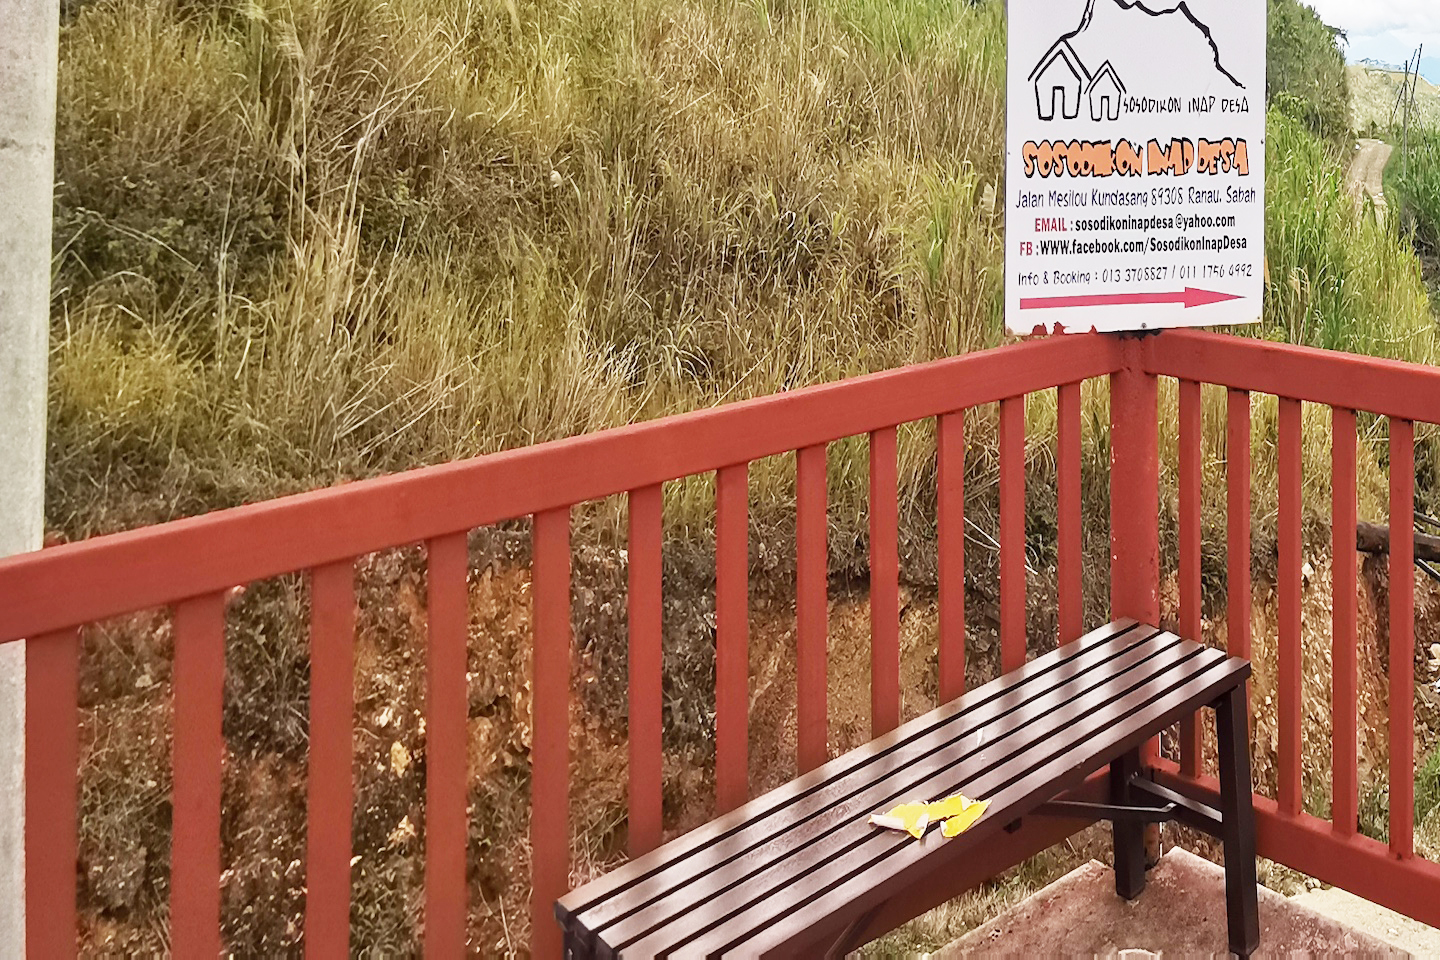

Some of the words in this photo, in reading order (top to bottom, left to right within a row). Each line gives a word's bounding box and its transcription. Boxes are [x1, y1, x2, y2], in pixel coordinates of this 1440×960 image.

[1123, 95, 1181, 113] SOSODIKON
[1221, 96, 1249, 113] DESA
[1021, 137, 1144, 178] SOSODIKON
[1147, 136, 1194, 177] INAP
[1196, 136, 1249, 176] DESA
[1015, 189, 1044, 208] Jalan
[1048, 189, 1087, 208] Mesilou
[1091, 188, 1148, 207] Kundasang
[1151, 186, 1184, 206] 89308
[1226, 185, 1256, 204] Sabah
[1018, 272, 1040, 286] Info
[1043, 271, 1049, 285] &
[1053, 270, 1091, 285] Booking
[1102, 268, 1121, 283] 013
[1125, 266, 1168, 282] 3708827
[1180, 265, 1196, 279] 011
